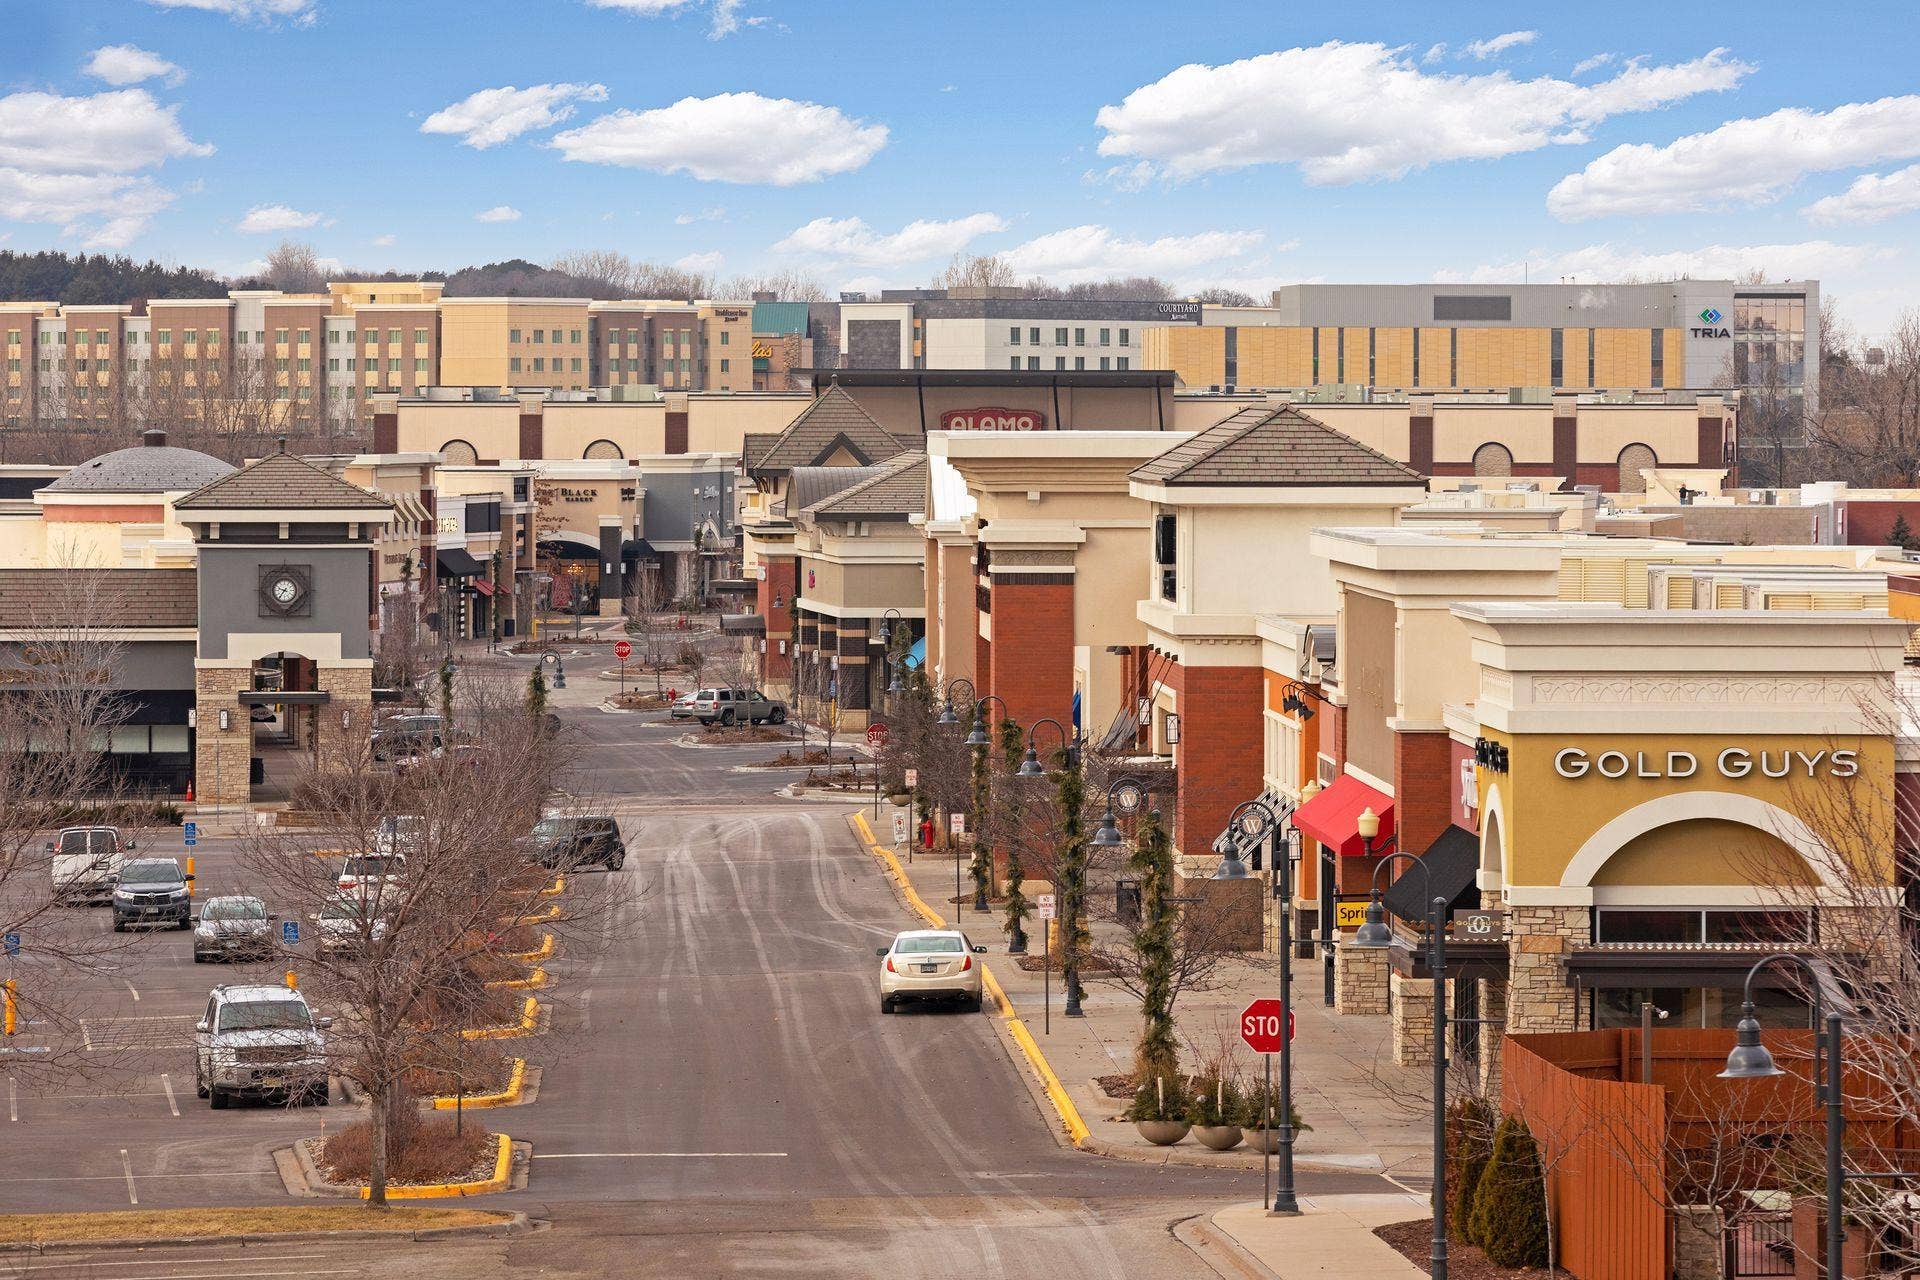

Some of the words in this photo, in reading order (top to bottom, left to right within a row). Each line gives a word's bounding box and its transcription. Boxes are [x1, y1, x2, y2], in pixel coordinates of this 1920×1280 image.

[1158, 303, 1199, 313] COURTYARD
[1690, 328, 1731, 338] TRIA
[951, 416, 1034, 431] ALAMO
[561, 487, 598, 496] BLACK
[615, 645, 630, 653] STOP
[868, 731, 888, 741] STOP
[1553, 747, 1698, 779] GOLD
[1716, 747, 1859, 779] GUYS
[1244, 819, 1262, 834] W
[1244, 1015, 1292, 1036] STO
